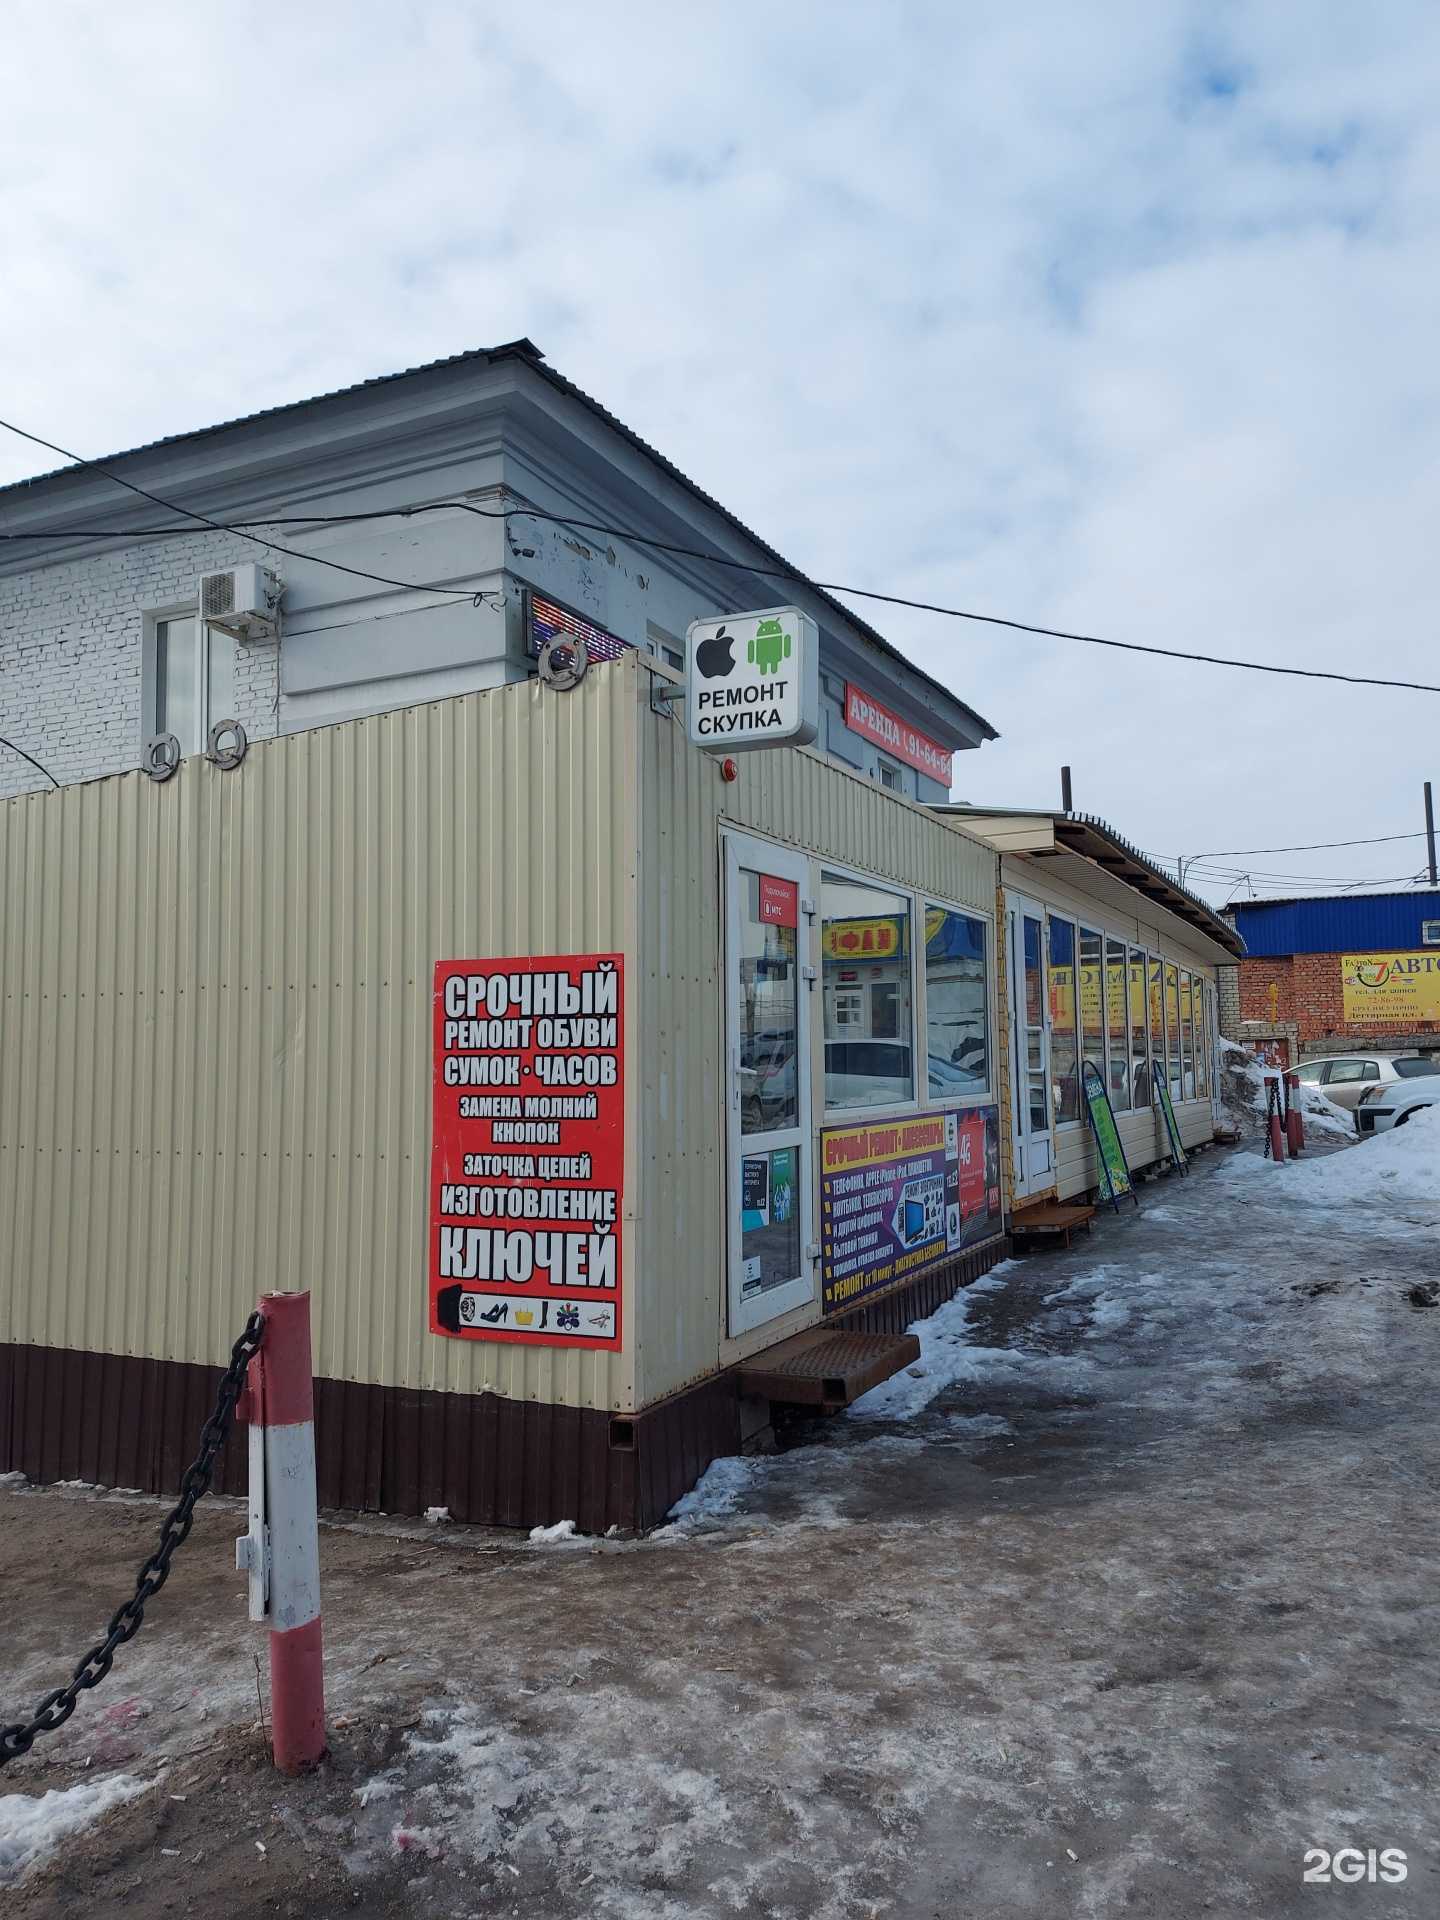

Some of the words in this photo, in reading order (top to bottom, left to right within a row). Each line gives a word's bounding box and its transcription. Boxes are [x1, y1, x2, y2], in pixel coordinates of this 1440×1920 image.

[698, 680, 789, 710] РЕМОНТ
[697, 708, 783, 735] СКУПКА
[850, 695, 900, 746] АРЕНДА
[1390, 957, 1440, 974] АВТ
[444, 961, 618, 1018] СРОЧНЫЙ
[444, 1018, 534, 1050] РЕМОНТ
[536, 1017, 617, 1049] ОБУВИ
[443, 1055, 521, 1086] СУМОК
[533, 1054, 618, 1086] ЧАСОВ
[459, 1096, 522, 1118] ЗАМЕНА
[524, 1093, 598, 1119] МОЛНИЙ
[491, 1121, 561, 1144] КНОПОК
[463, 1154, 536, 1177] ЗАТОЧКА
[537, 1152, 592, 1181] ЦЕПЕЙ
[440, 1184, 617, 1221] ИЗГОТОВЛЕНИЕ
[439, 1222, 618, 1288] КЛЮЧЕЙ
[834, 1271, 865, 1302] РЕМОНТ
